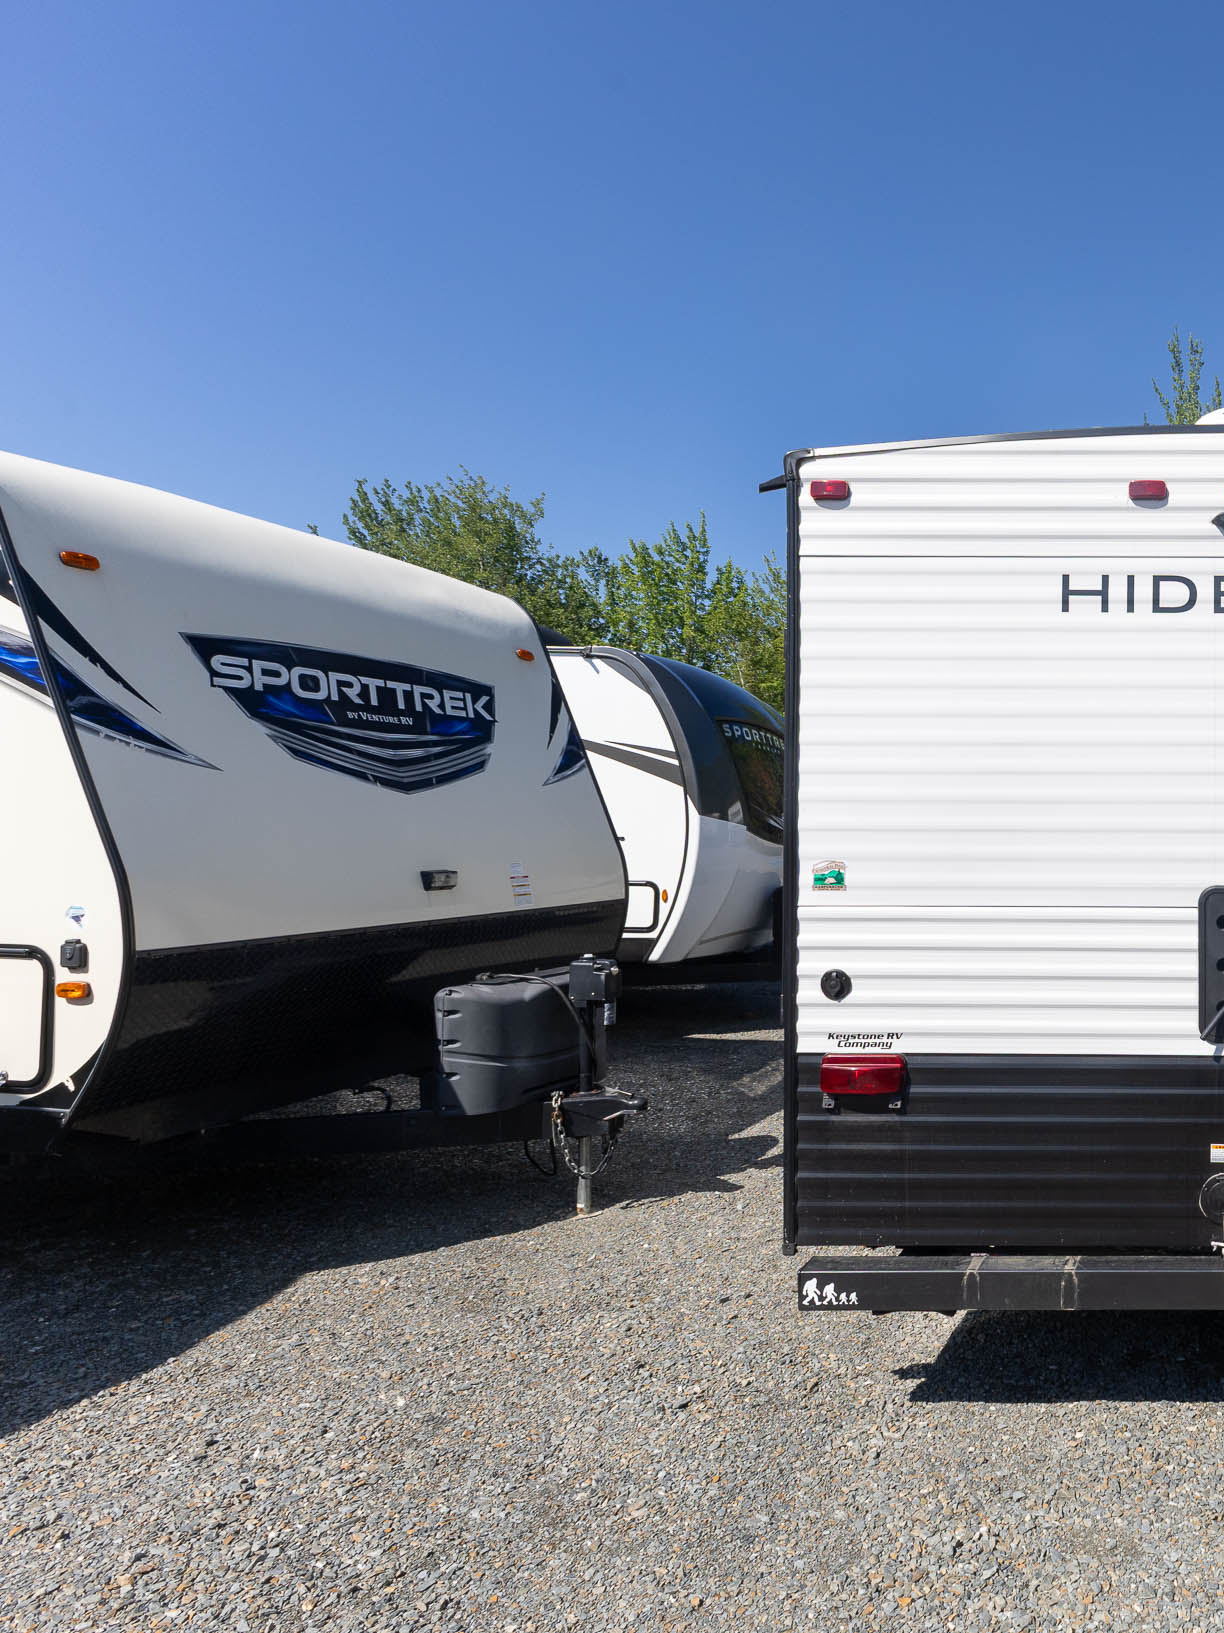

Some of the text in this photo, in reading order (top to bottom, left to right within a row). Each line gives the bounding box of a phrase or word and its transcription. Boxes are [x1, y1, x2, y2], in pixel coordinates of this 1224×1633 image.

[210, 654, 494, 721] SPORTTREK
[346, 711, 413, 726] BY VENTURE RV
[827, 1032, 903, 1041] Keystone RV
[837, 1040, 893, 1050] Company
